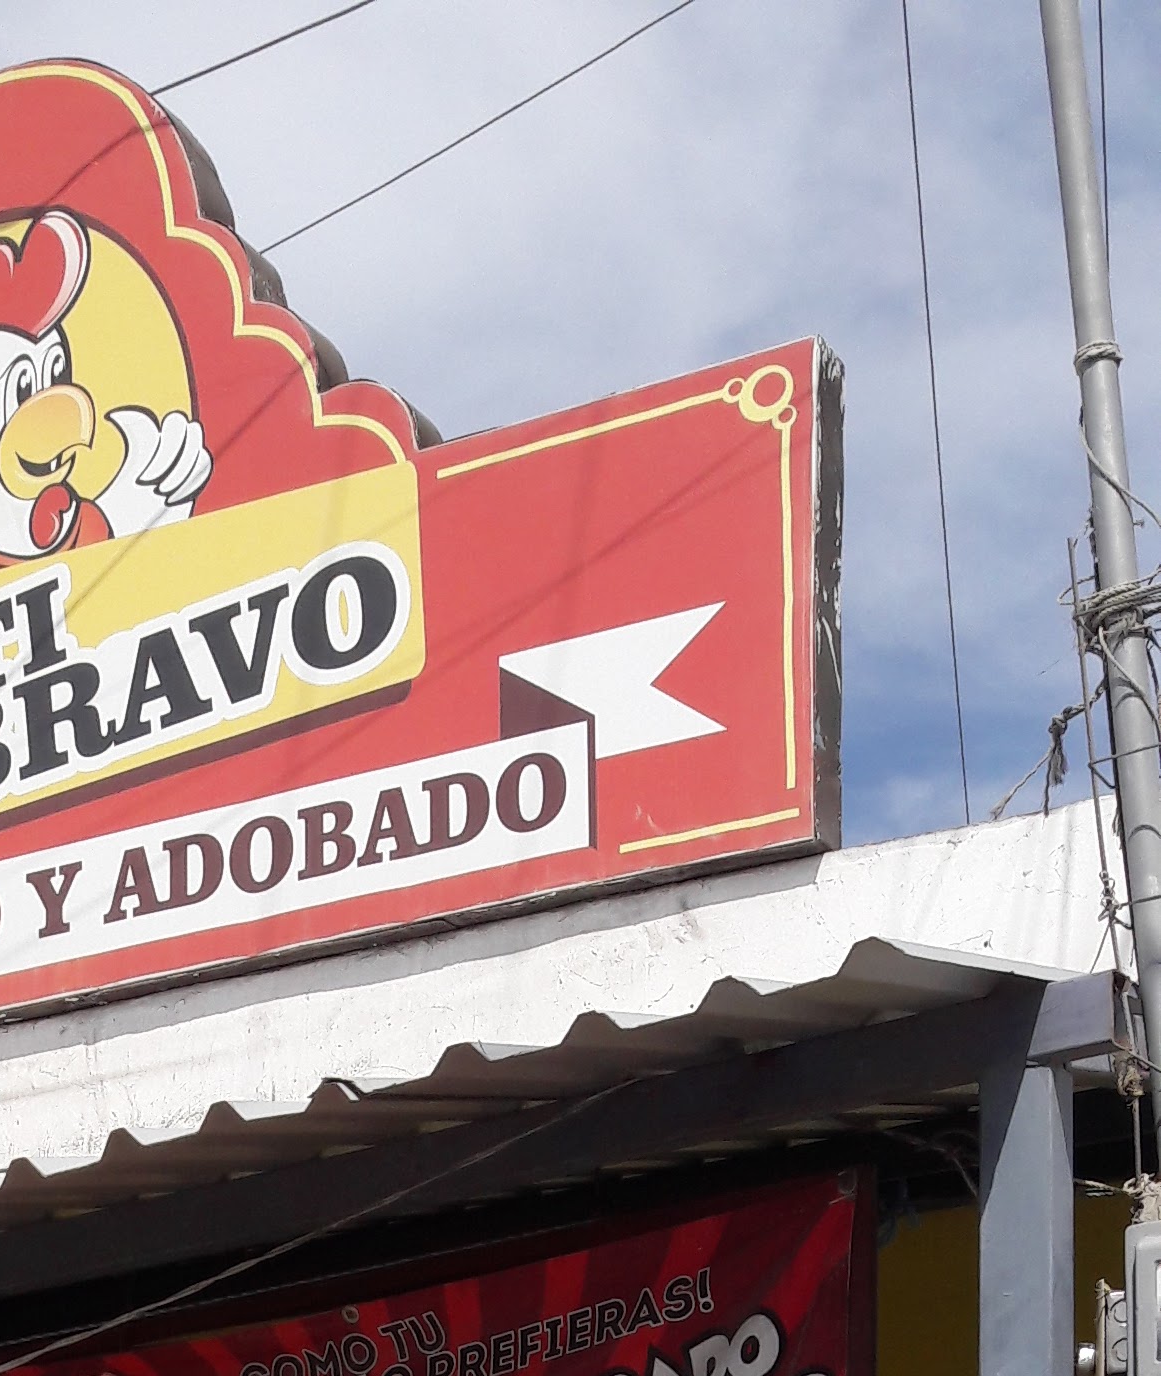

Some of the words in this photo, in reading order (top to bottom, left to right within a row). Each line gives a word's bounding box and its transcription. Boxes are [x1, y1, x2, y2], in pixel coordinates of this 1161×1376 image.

[27, 862, 82, 935] Y
[102, 750, 568, 925] ADOBADO
[379, 1309, 447, 1364] TU
